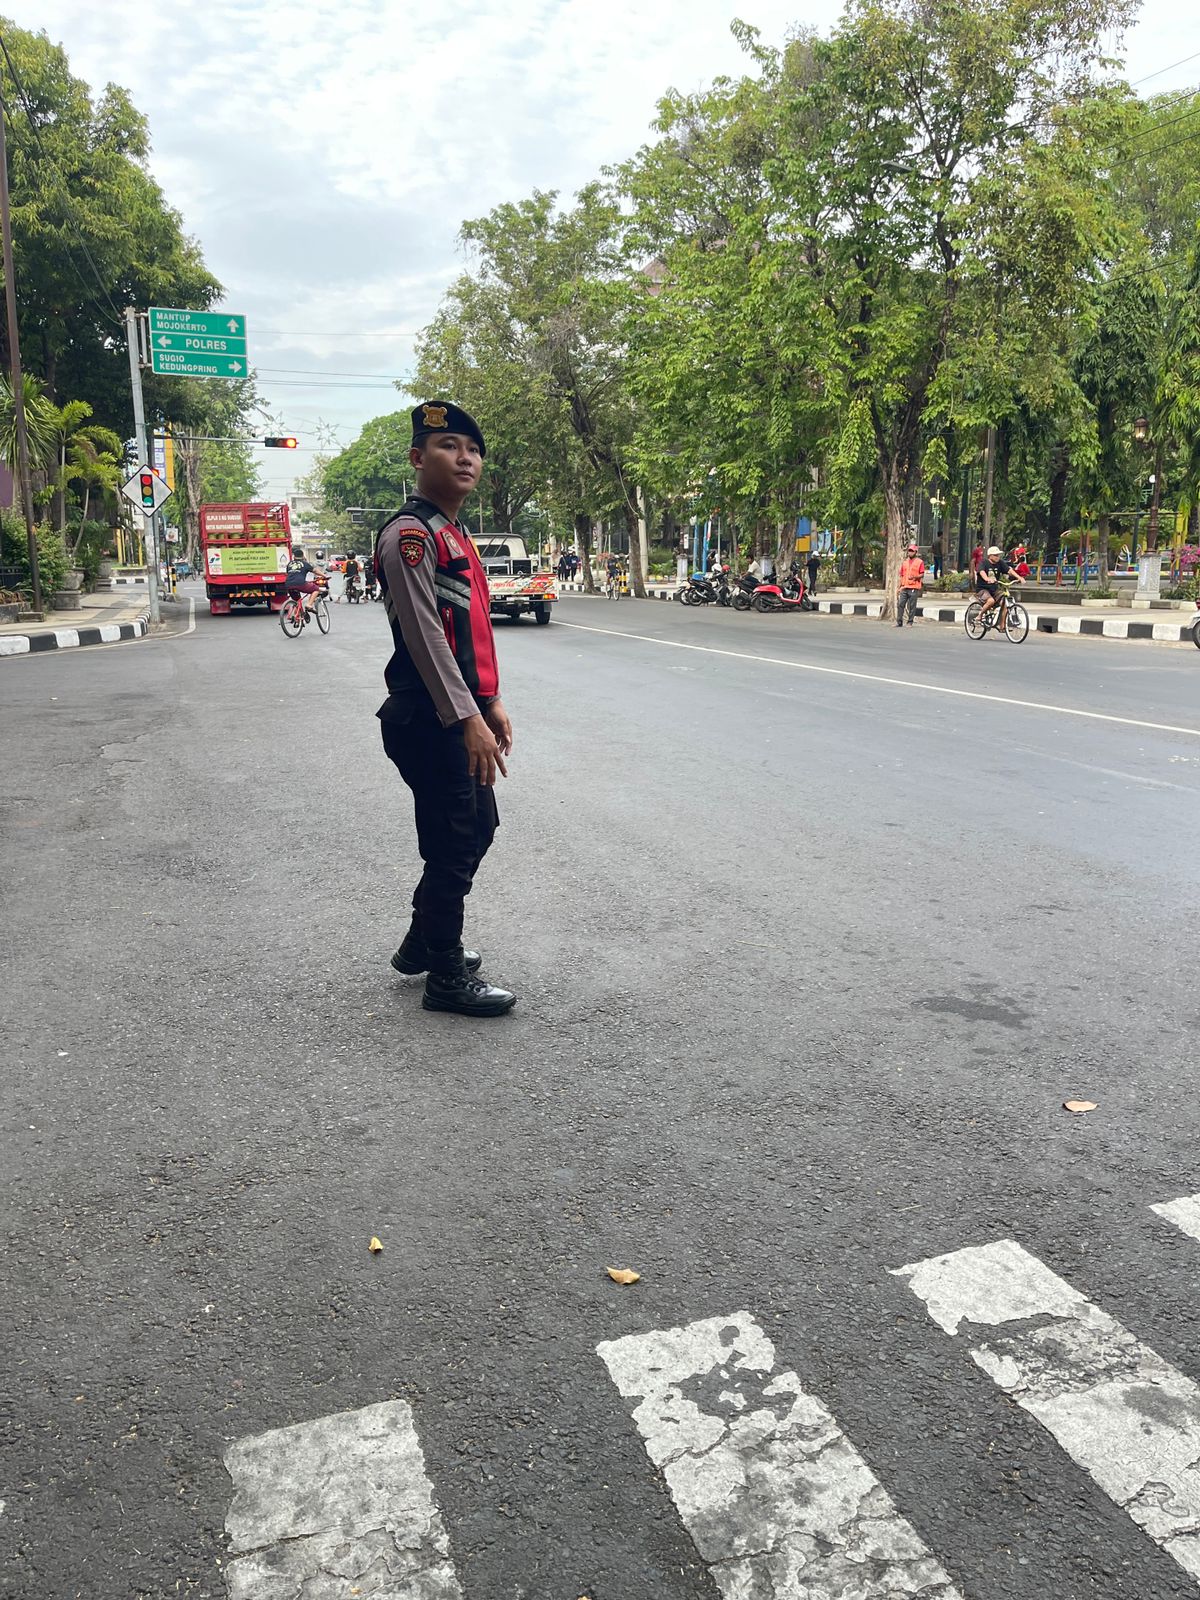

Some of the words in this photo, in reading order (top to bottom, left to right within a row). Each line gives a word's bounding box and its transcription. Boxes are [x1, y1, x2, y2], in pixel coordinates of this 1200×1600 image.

[156, 312, 191, 322] MANTUP
[157, 322, 207, 332] MOJOKERTO
[185, 338, 227, 351] POLRES
[159, 353, 185, 362] SUGIO
[159, 362, 218, 373] KEDUNGPRING
